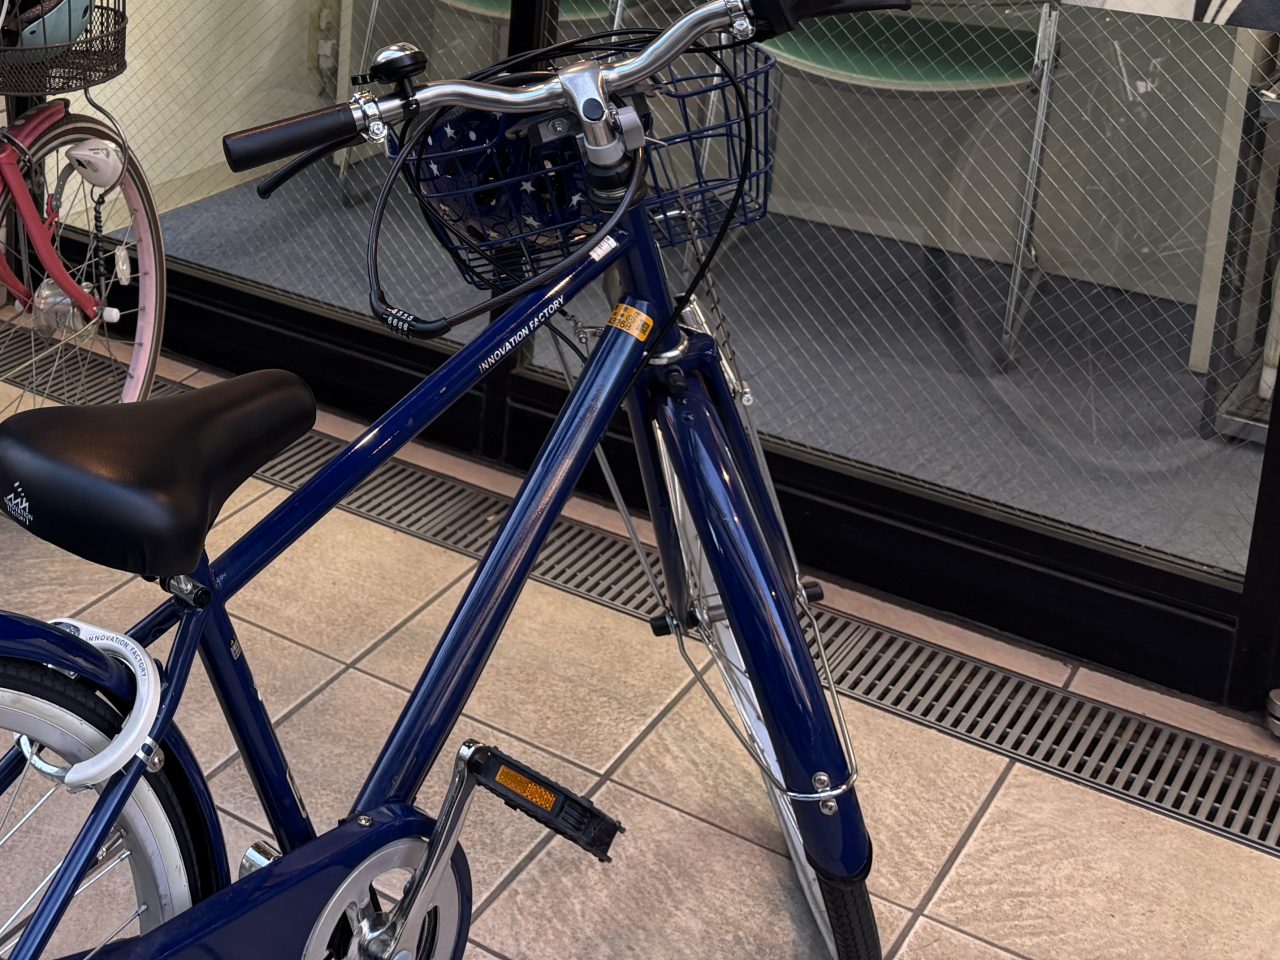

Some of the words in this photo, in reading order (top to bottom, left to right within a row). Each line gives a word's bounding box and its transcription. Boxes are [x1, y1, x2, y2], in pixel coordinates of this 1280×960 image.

[478, 326, 529, 374] INNOVATION
[528, 294, 564, 331] FACTORY
[85, 634, 129, 649] INNOVATION
[129, 647, 147, 678] FACTORY
